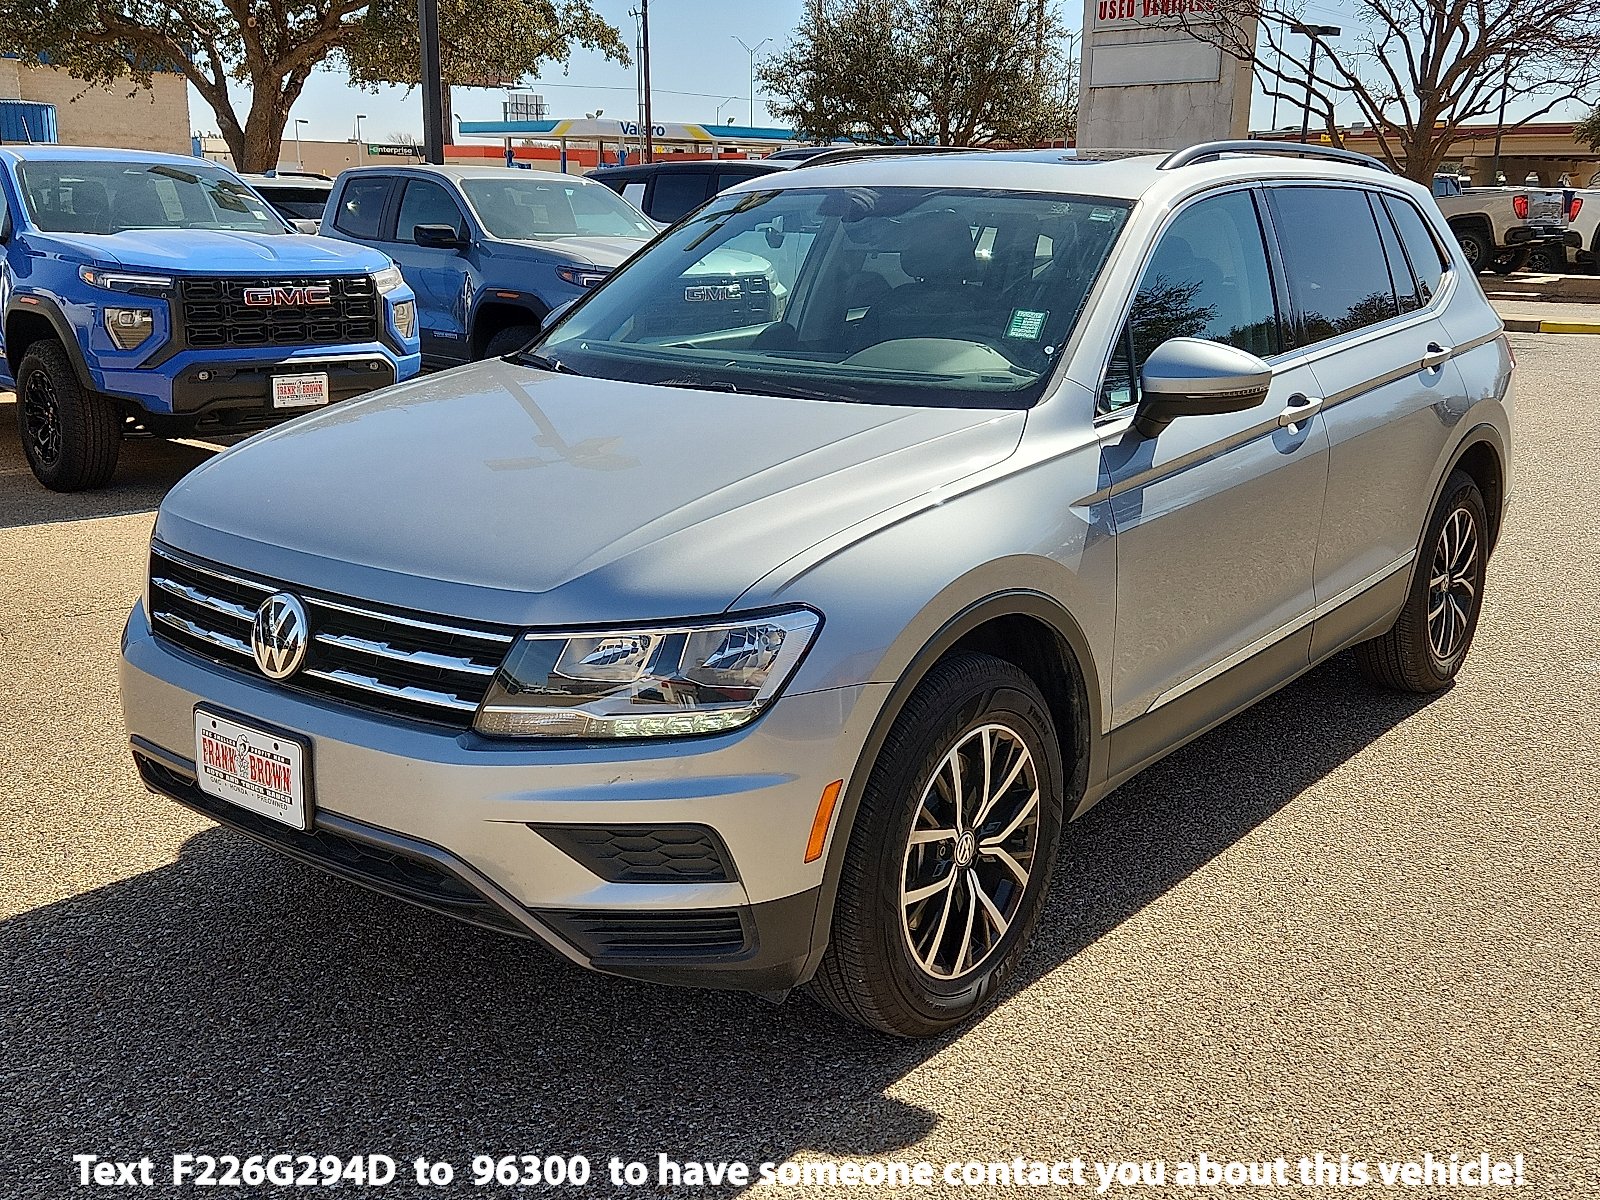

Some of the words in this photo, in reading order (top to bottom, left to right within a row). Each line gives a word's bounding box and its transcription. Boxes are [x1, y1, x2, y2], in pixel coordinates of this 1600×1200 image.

[1099, 0, 1135, 20] USED
[244, 286, 330, 306] GMC
[684, 286, 741, 301] GMC
[202, 737, 238, 774] FRANK
[249, 754, 292, 795] BROWN
[206, 767, 224, 779] AUTO
[225, 773, 239, 784] AND
[241, 778, 265, 793] TRUCK
[266, 788, 291, 803] RANCH
[256, 793, 288, 810] PREOWNED
